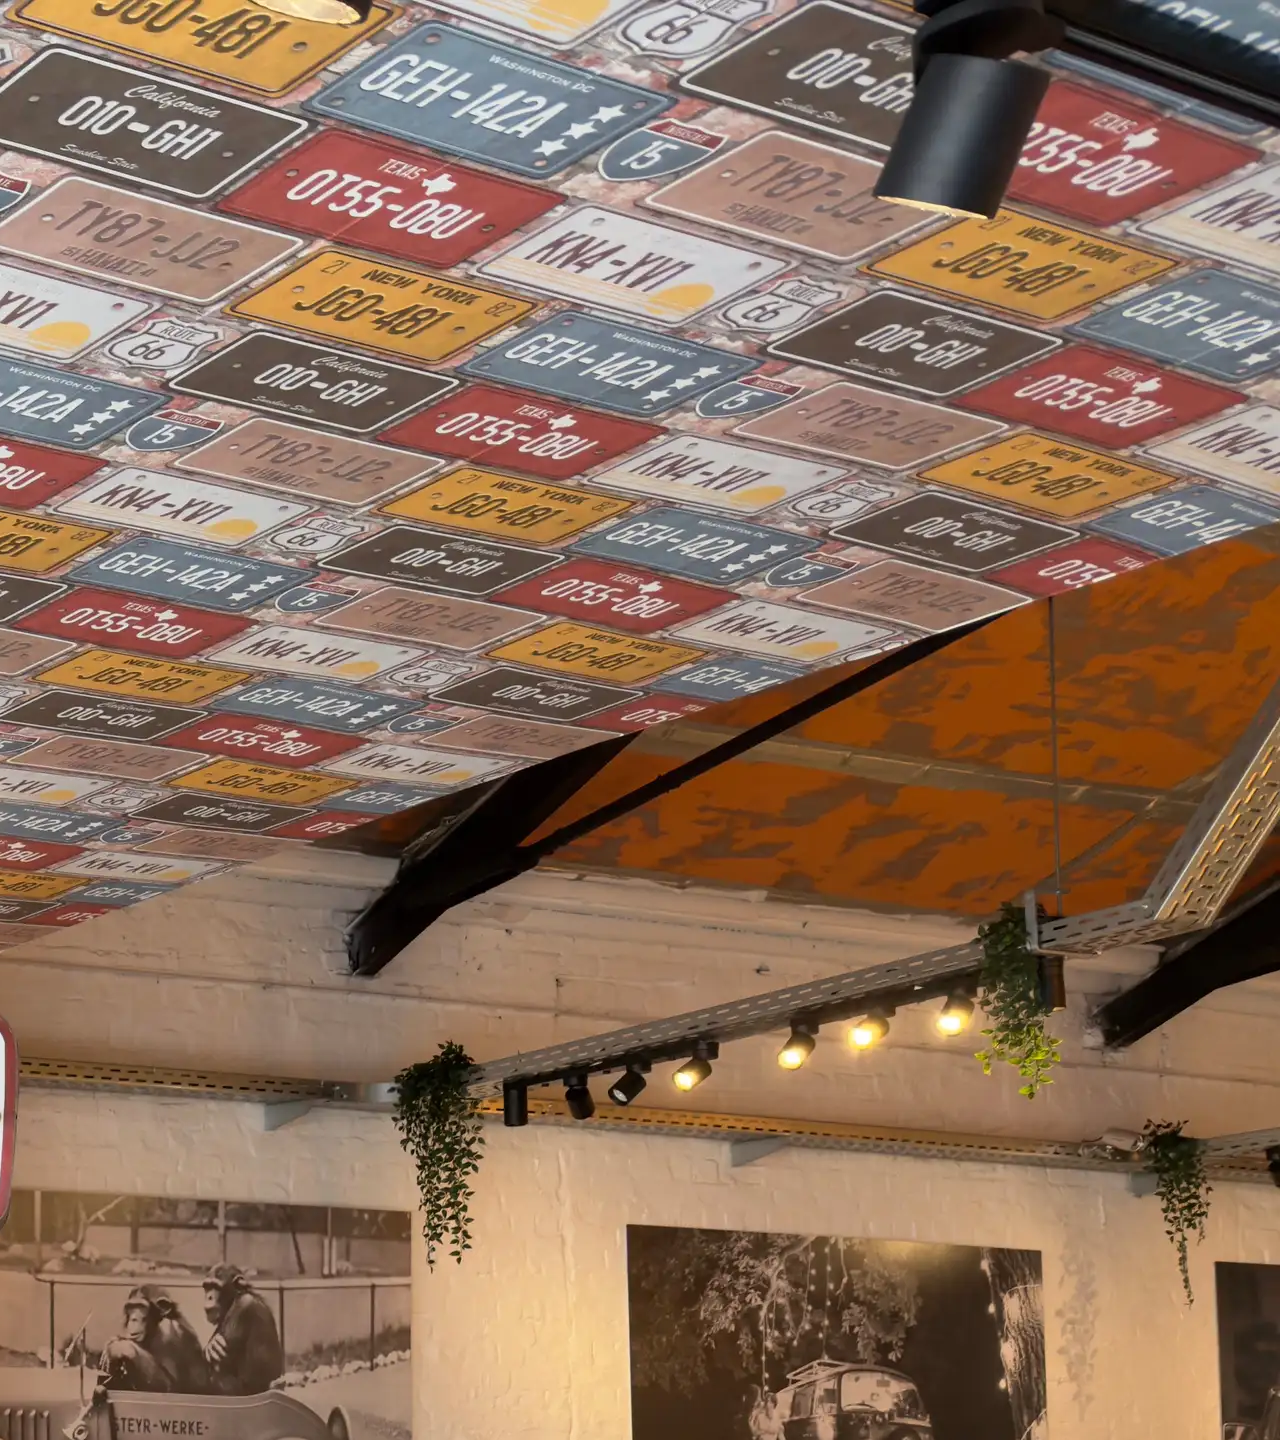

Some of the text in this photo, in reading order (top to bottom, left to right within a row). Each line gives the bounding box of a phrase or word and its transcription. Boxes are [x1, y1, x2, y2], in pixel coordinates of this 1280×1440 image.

[122, 86, 224, 117] California
[362, 55, 570, 136] GEH-142A
[618, 141, 681, 168] 15
[377, 158, 432, 180] TEXAS
[312, 261, 350, 276] 21
[526, 232, 696, 291] KN4-XV1
[355, 269, 485, 306] NEW YORK
[784, 286, 827, 301] ROUTE
[481, 302, 518, 318] 82
[741, 301, 793, 321] 66
[93, 482, 234, 524] KN4-XV1
[351, 753, 458, 775] KN4-XV1
